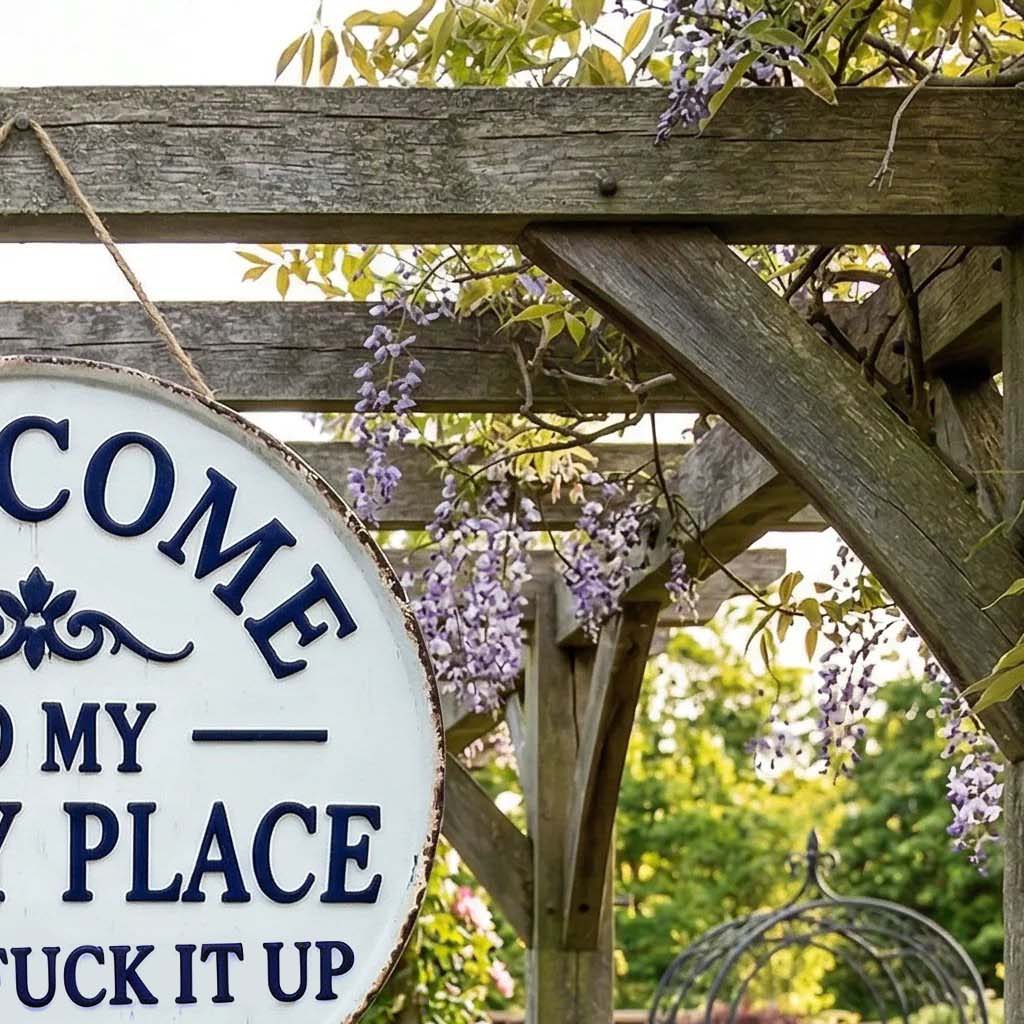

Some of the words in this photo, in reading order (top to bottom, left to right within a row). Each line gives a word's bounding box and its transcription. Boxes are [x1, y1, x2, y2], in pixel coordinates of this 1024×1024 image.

[40, 701, 157, 774] MY
[61, 801, 383, 905] PLACE
[174, 942, 245, 1005] IT
[262, 940, 355, 1003] UP
